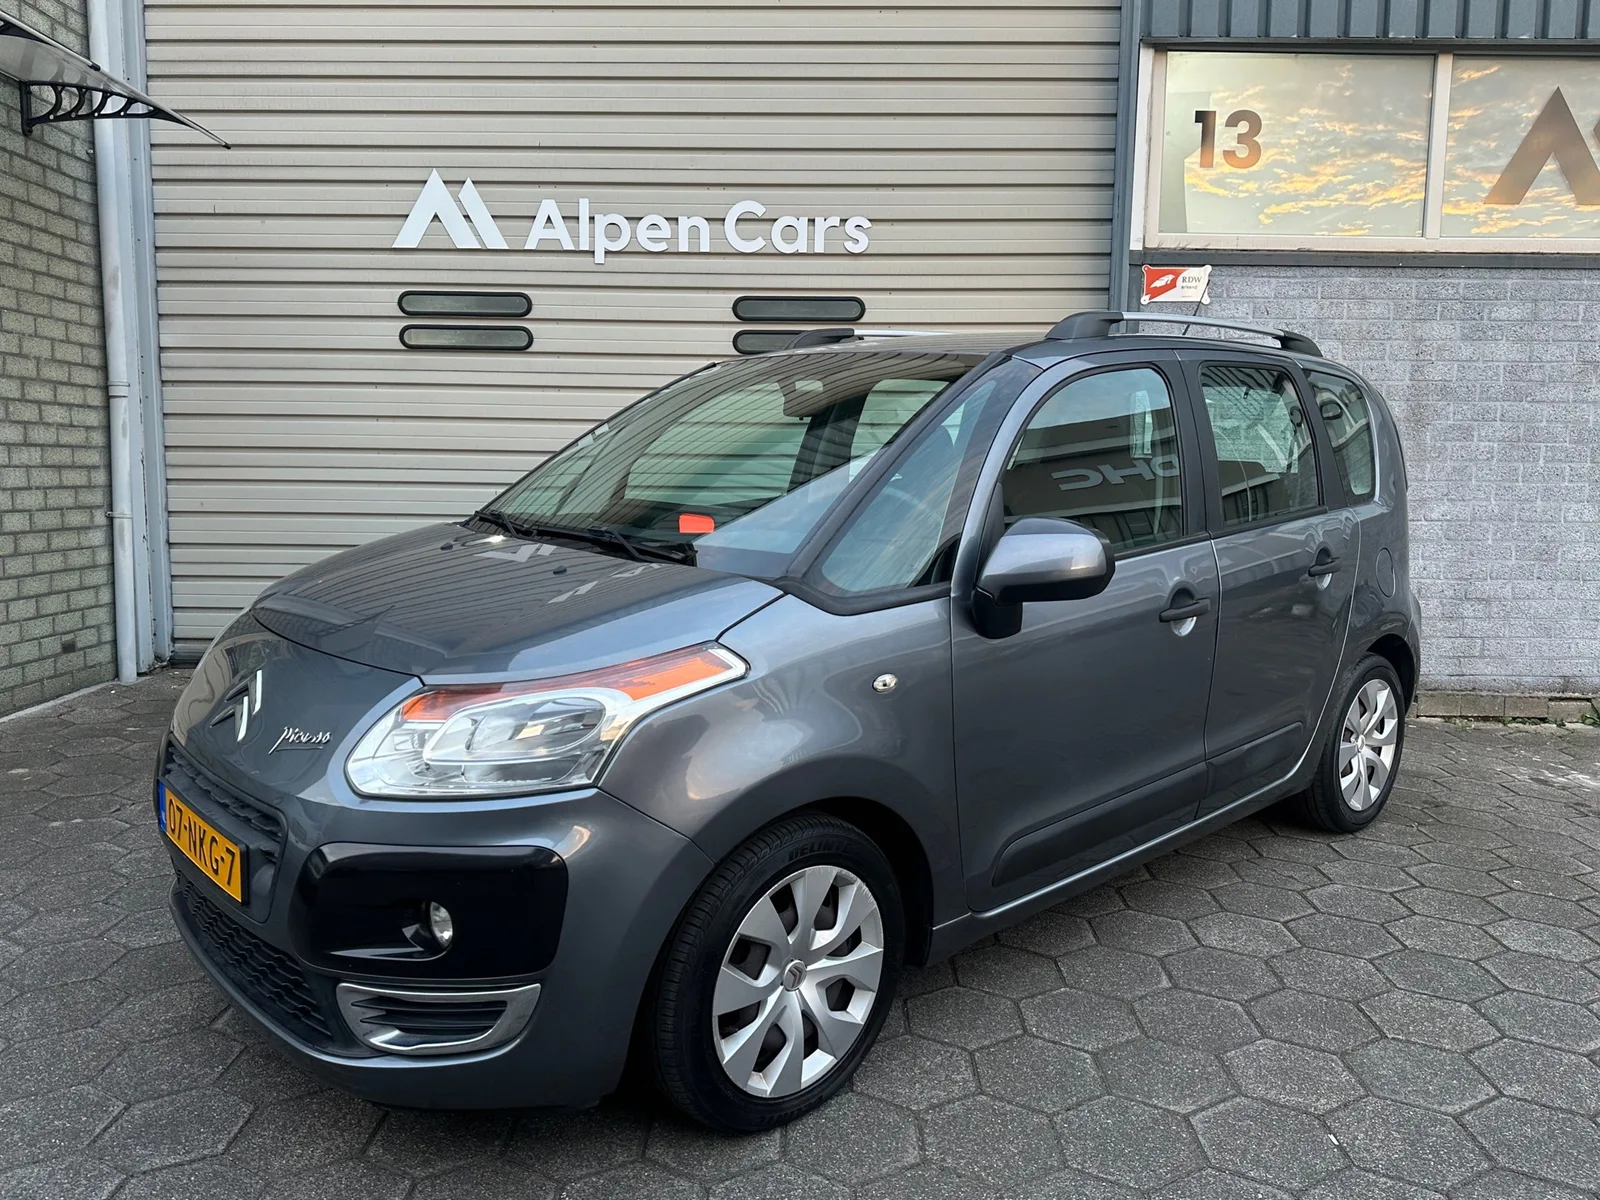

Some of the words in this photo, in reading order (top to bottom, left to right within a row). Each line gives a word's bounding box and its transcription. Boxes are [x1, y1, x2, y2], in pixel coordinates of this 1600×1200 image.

[1194, 109, 1263, 169] 13
[523, 197, 711, 264] Alpen
[724, 200, 873, 255] Cars
[1181, 275, 1203, 284] RDW
[168, 798, 236, 887] 07-NKG-7
